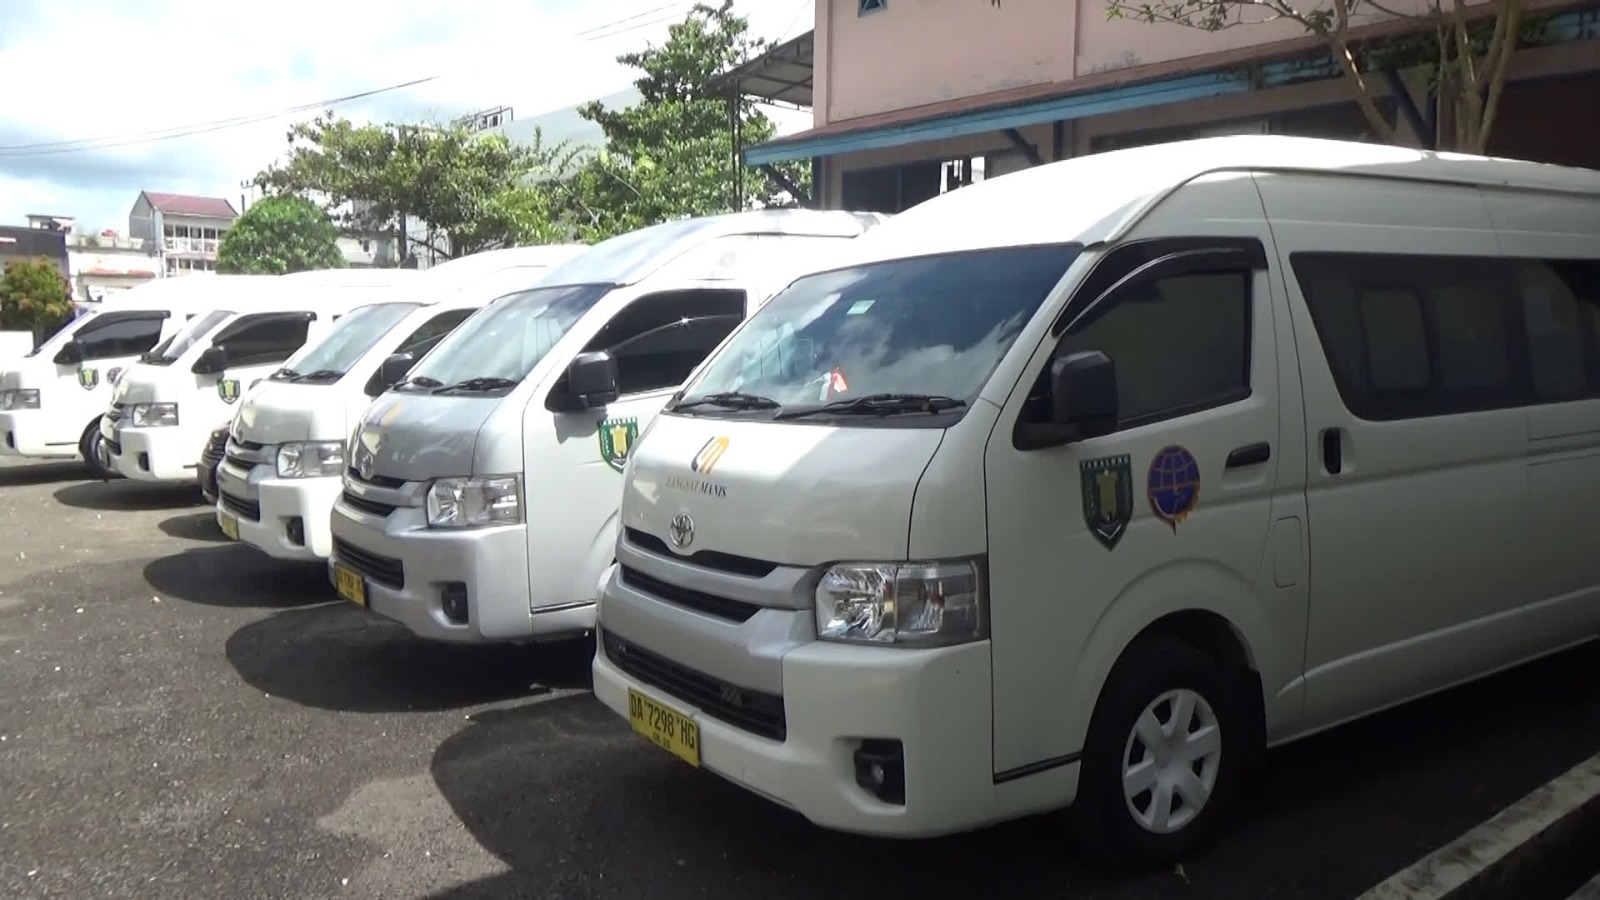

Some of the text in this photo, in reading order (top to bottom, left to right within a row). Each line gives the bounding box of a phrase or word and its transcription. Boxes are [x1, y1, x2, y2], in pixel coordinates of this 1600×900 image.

[1082, 456, 1129, 470] TABALONG
[700, 481, 728, 499] MANIS
[630, 693, 644, 721] DA
[648, 703, 674, 738] 7298
[681, 719, 695, 750] HG
